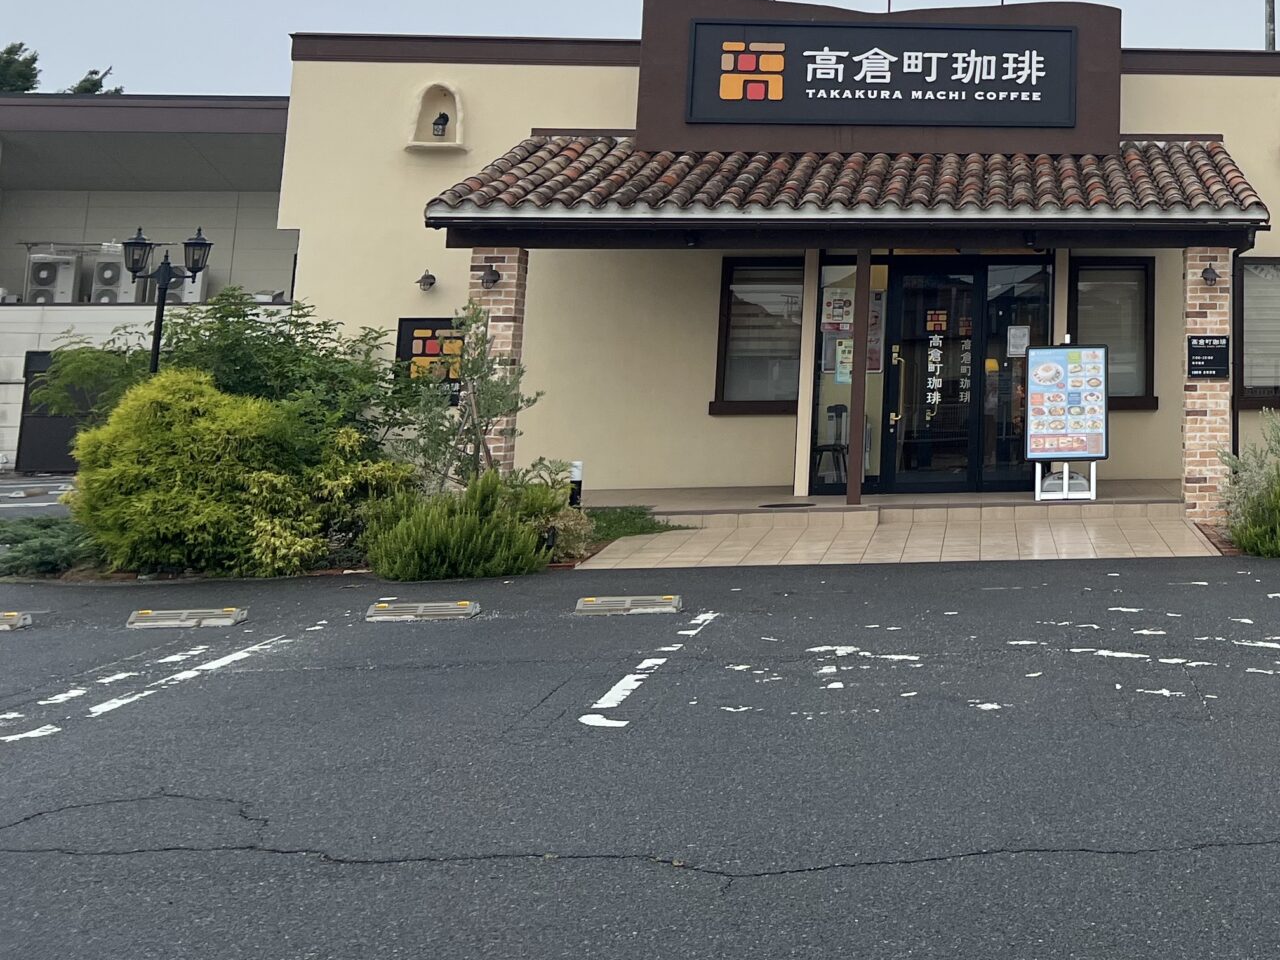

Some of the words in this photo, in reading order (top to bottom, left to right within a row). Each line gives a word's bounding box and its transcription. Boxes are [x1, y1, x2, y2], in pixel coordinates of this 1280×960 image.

[802, 46, 1047, 86] 高倉町珈琲
[806, 89, 903, 100] TAKAKURA
[911, 90, 967, 101] MACHI
[974, 91, 1043, 102] COFFEE
[926, 334, 944, 405] 高倉町珈琲
